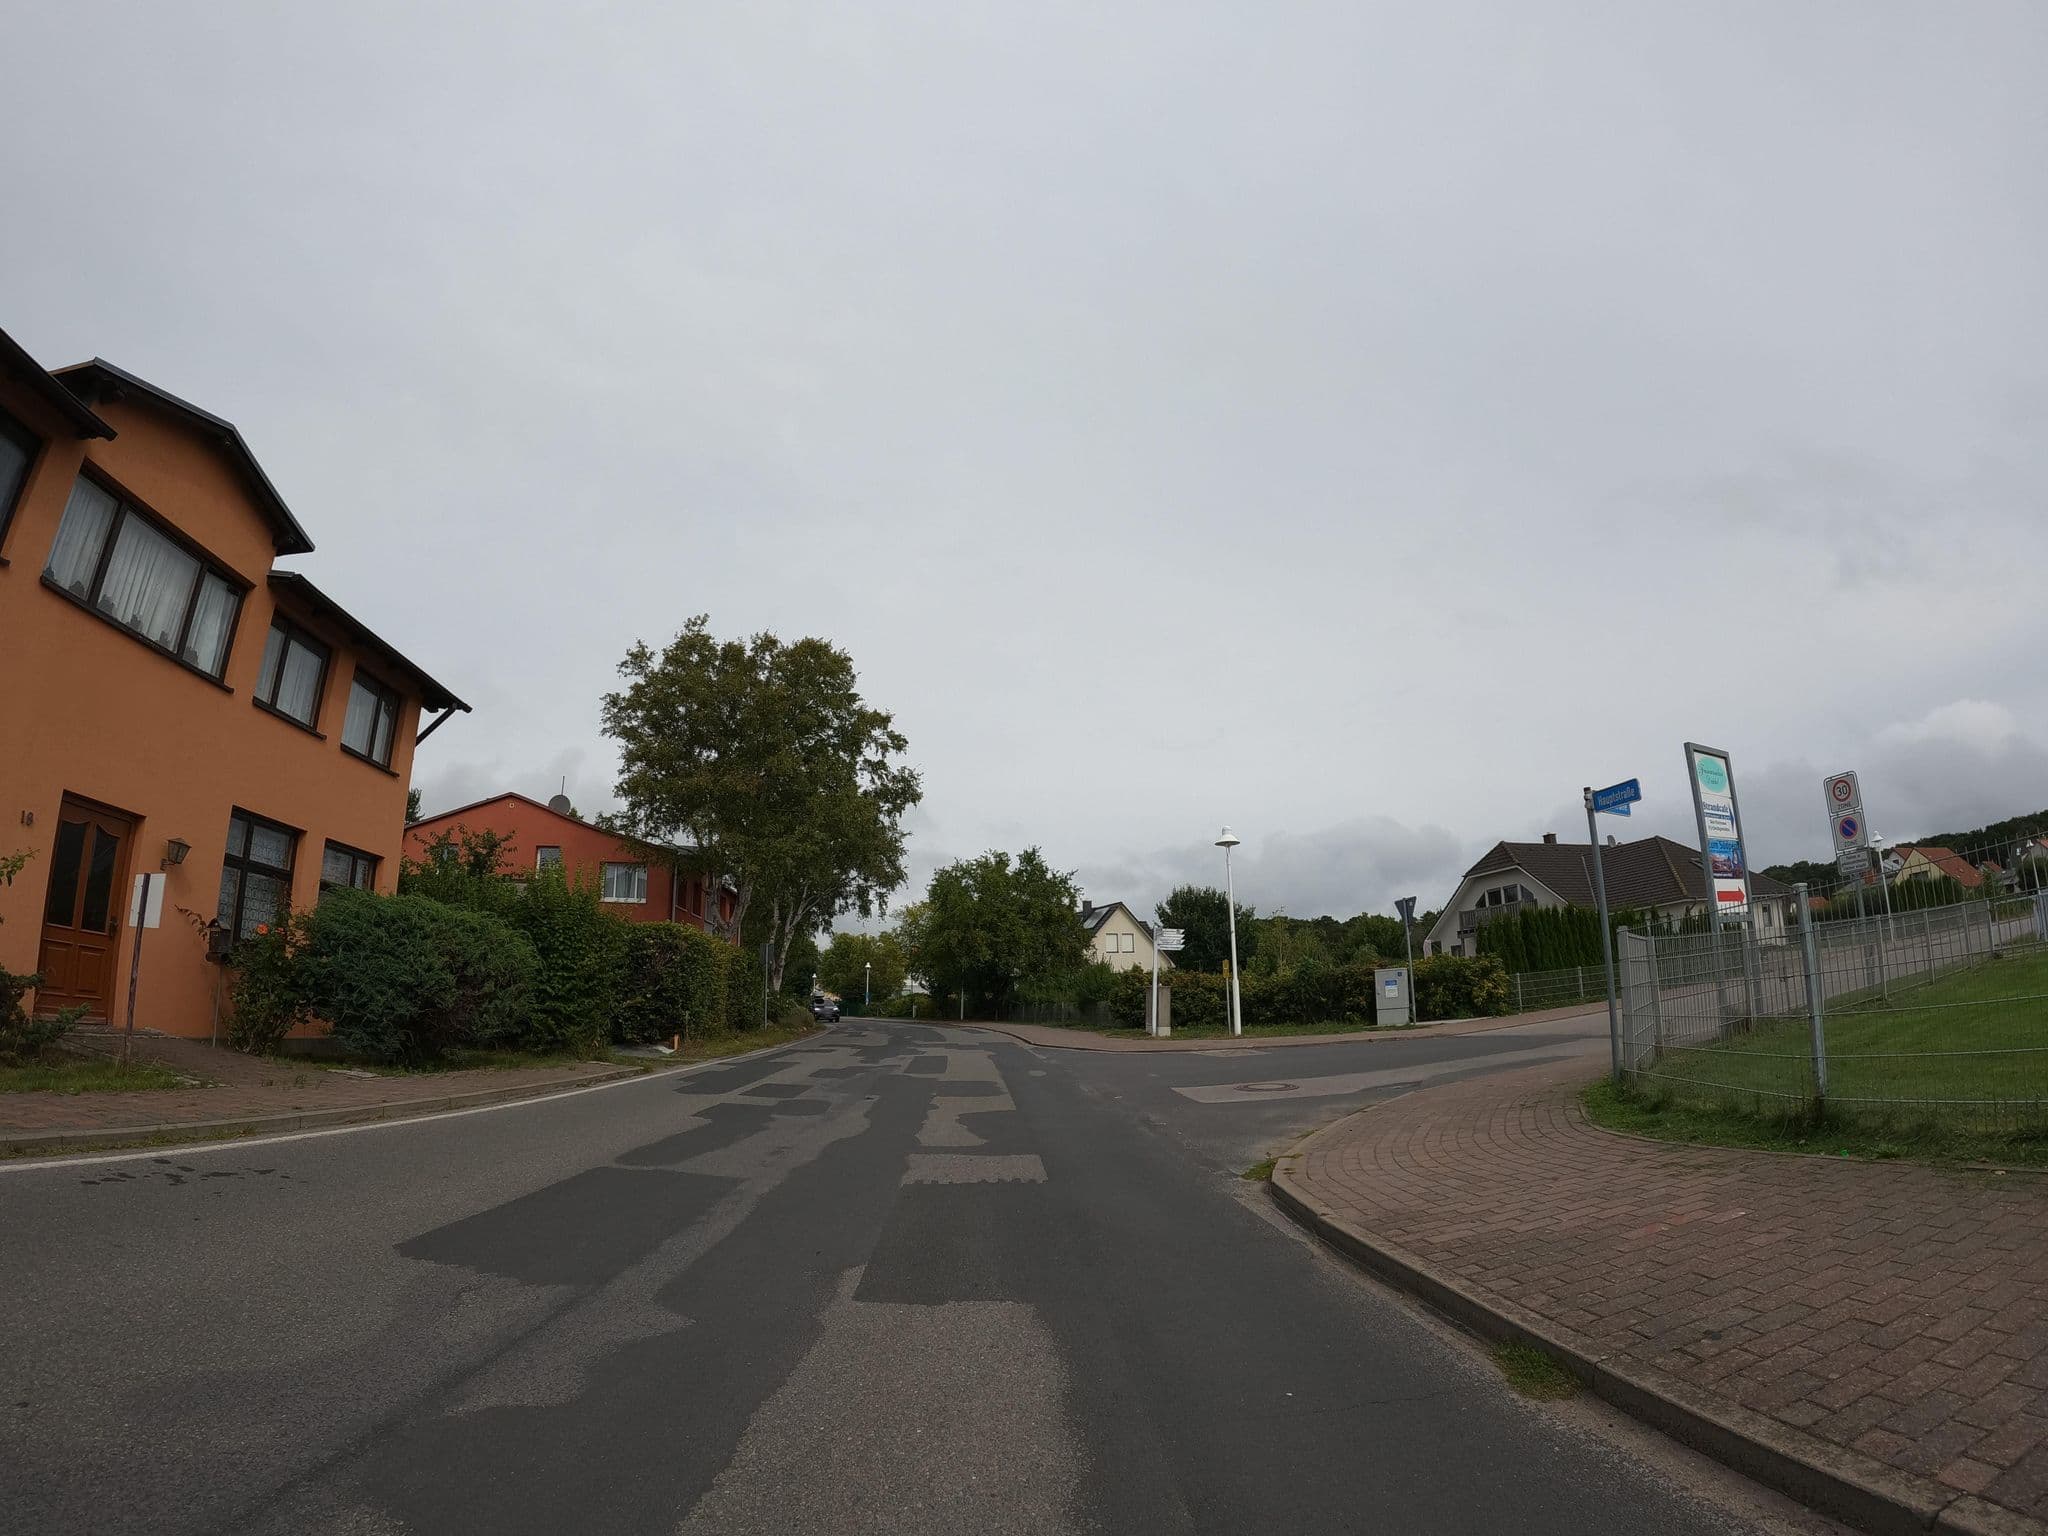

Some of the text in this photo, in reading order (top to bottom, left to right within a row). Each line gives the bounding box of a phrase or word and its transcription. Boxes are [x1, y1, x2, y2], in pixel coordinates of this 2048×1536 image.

[1597, 786, 1636, 807] Hauptstraße
[1836, 785, 1848, 797] 30
[1838, 801, 1852, 810] ZONE
